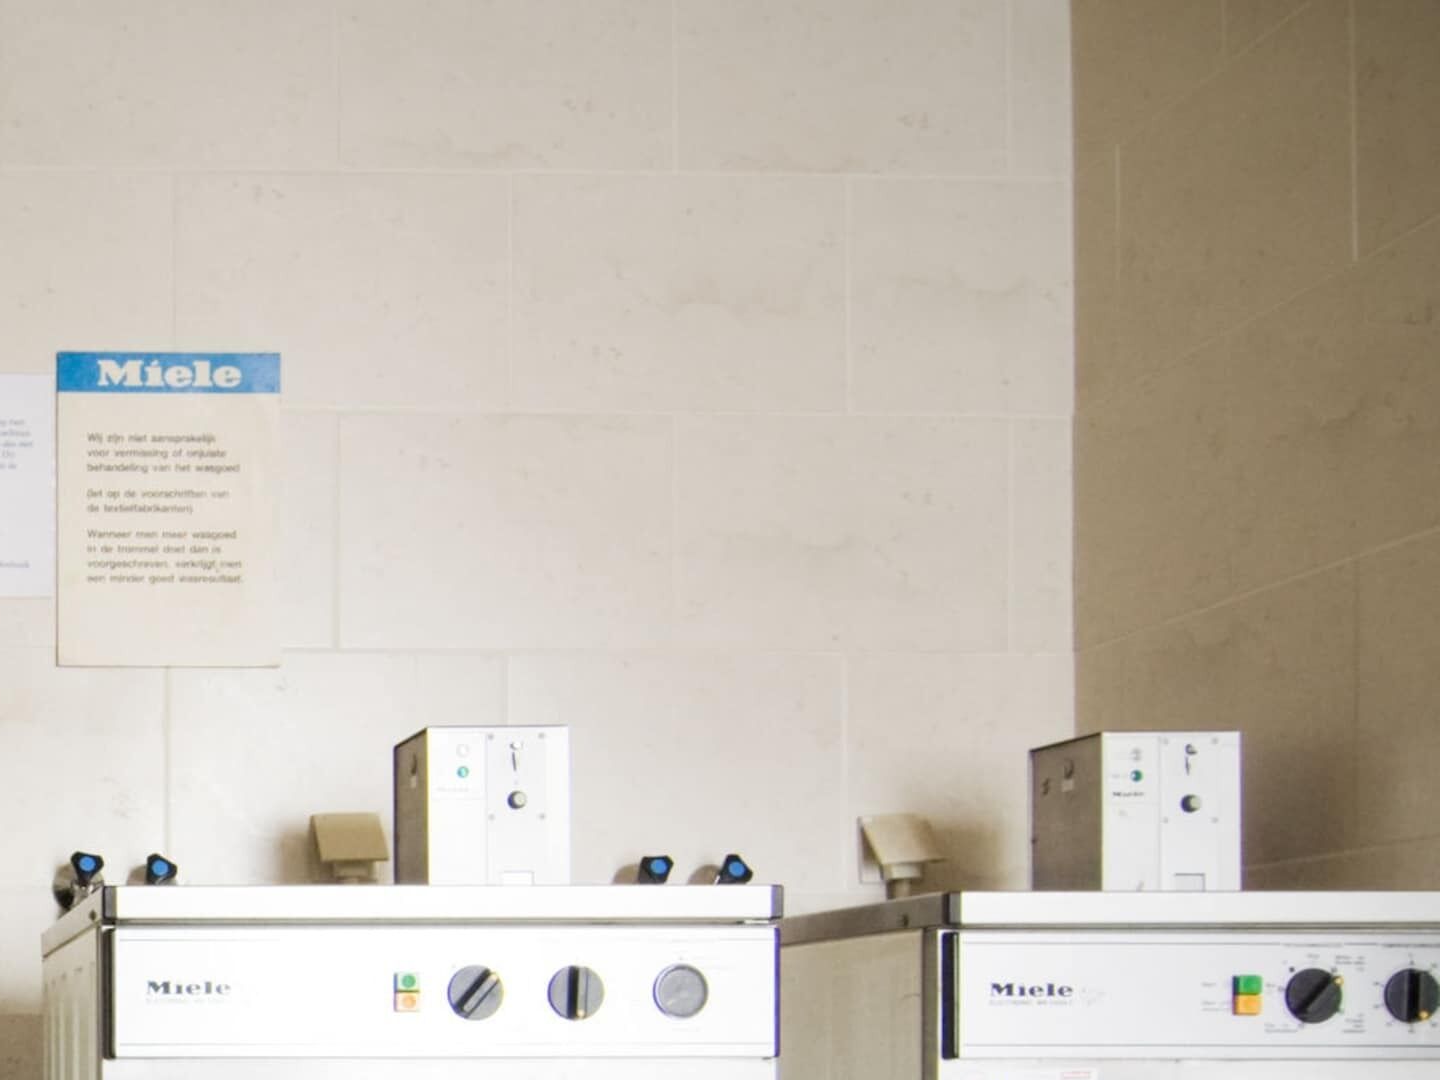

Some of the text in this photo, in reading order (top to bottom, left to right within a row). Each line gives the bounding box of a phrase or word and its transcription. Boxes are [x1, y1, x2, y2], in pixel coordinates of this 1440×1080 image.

[97, 358, 242, 388] Miele
[87, 432, 216, 444] Wij zijn niet aansprakelijk
[87, 448, 227, 460] voor vermissing of onjuiste
[86, 463, 148, 475] behandeling
[152, 464, 171, 472] van
[174, 463, 191, 473] het
[106, 490, 121, 500] op
[124, 488, 137, 498] de
[141, 488, 208, 499] voorschriften
[211, 490, 230, 498] van
[86, 504, 100, 513] de
[87, 529, 238, 541] Wanneer men meer wasgoed
[87, 544, 222, 554] in de trommel doet dan is
[175, 558, 216, 571] verkrijgt
[219, 560, 243, 569] men
[109, 574, 145, 583] minder
[148, 574, 175, 585] goed
[146, 980, 232, 996] Miele
[990, 982, 1074, 998] Miele
